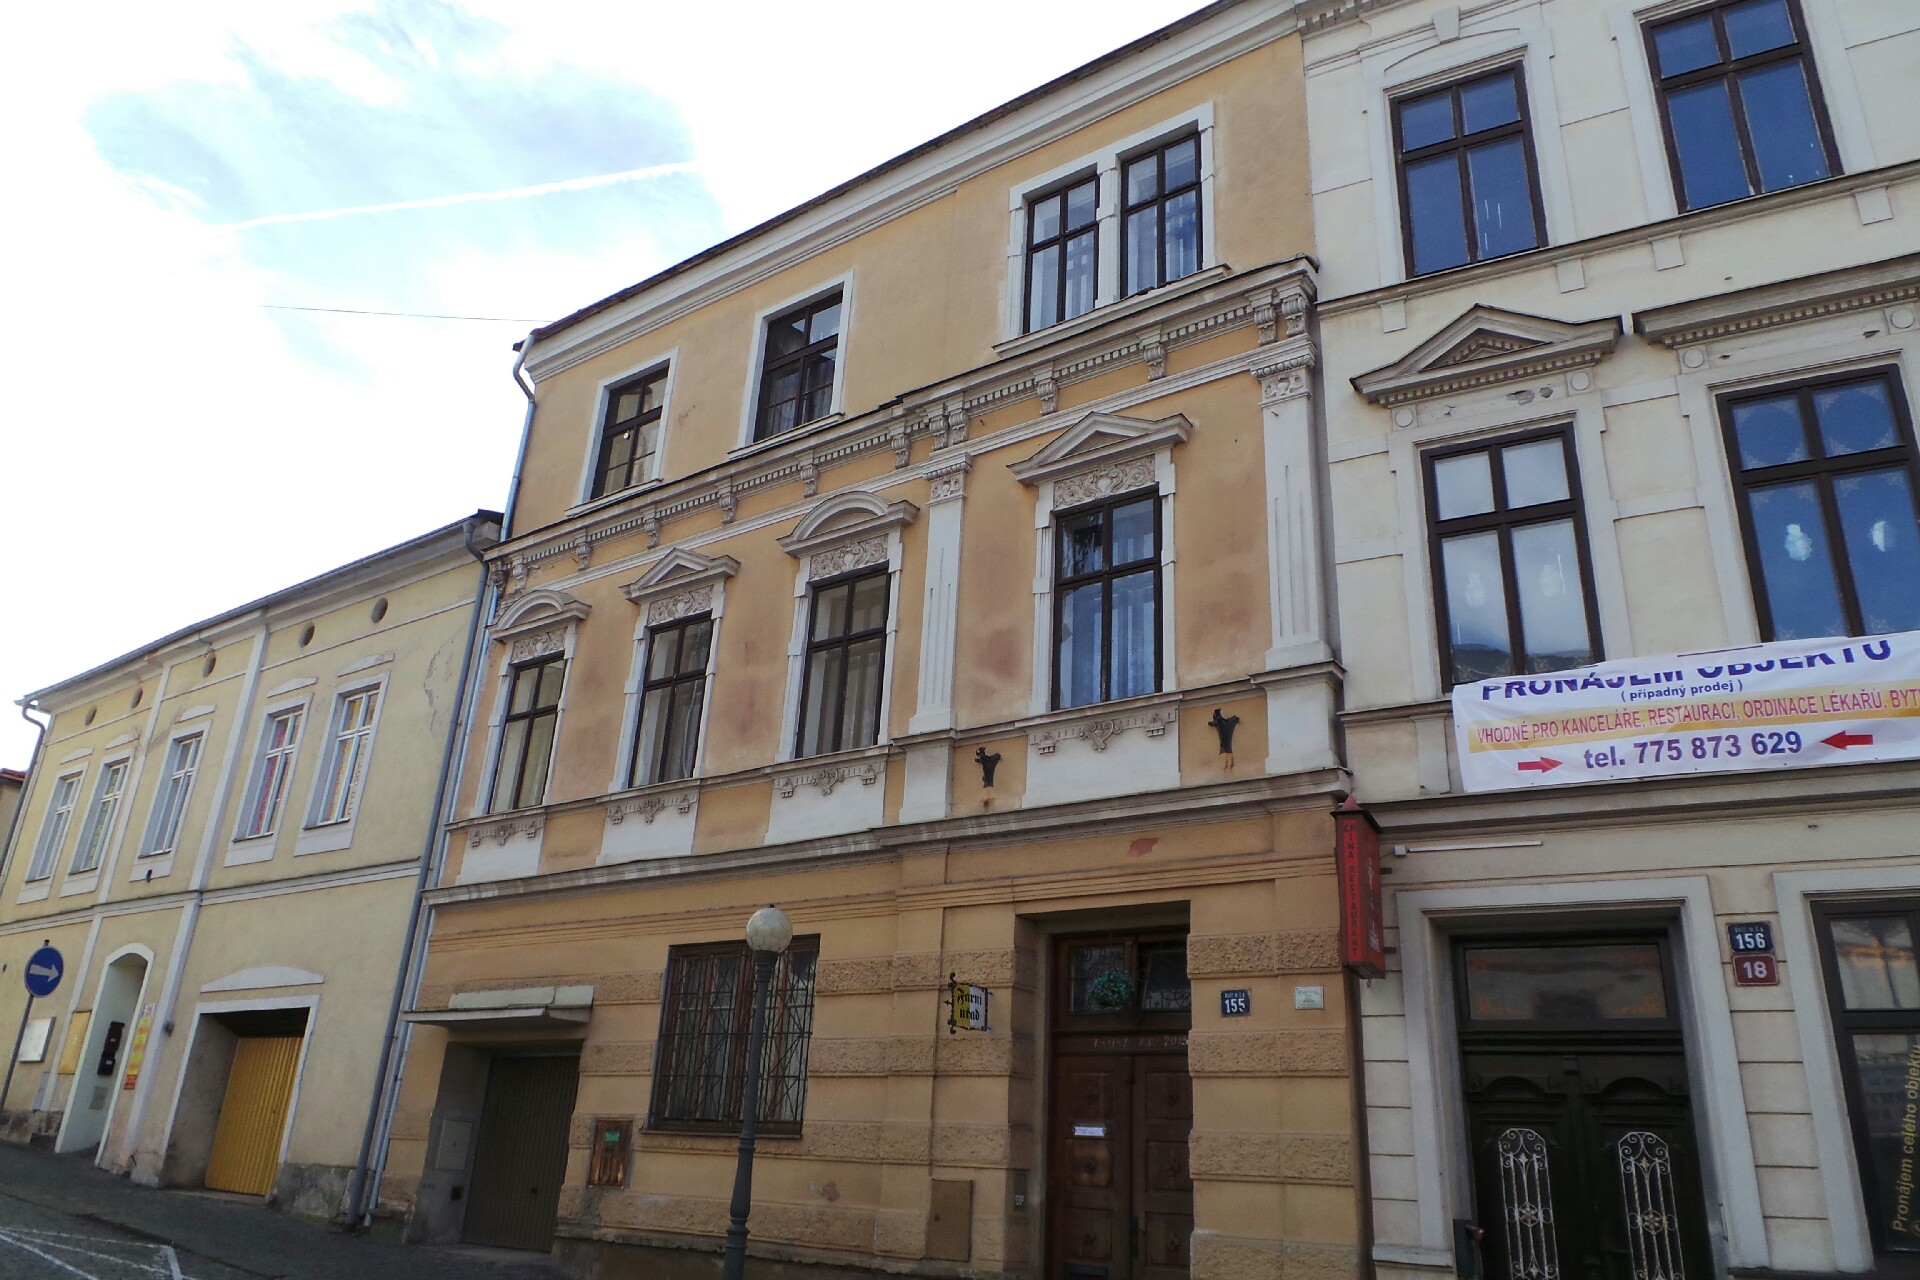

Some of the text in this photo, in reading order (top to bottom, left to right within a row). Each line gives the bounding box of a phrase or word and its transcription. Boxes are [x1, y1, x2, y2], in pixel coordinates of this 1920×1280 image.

[1629, 684, 1686, 702] případný
[1691, 679, 1734, 696] prodej
[1477, 721, 1529, 744] VHODNÉ
[1533, 721, 1559, 740] PRO
[1743, 695, 1818, 718] ORDINACE
[1584, 730, 1803, 769] tel. 775 873 629
[1736, 932, 1766, 950] 156
[1743, 961, 1768, 979] 18
[1225, 998, 1246, 1013] 155
[1901, 1104, 1918, 1154] celého
[1893, 1158, 1914, 1232] Pronájem
